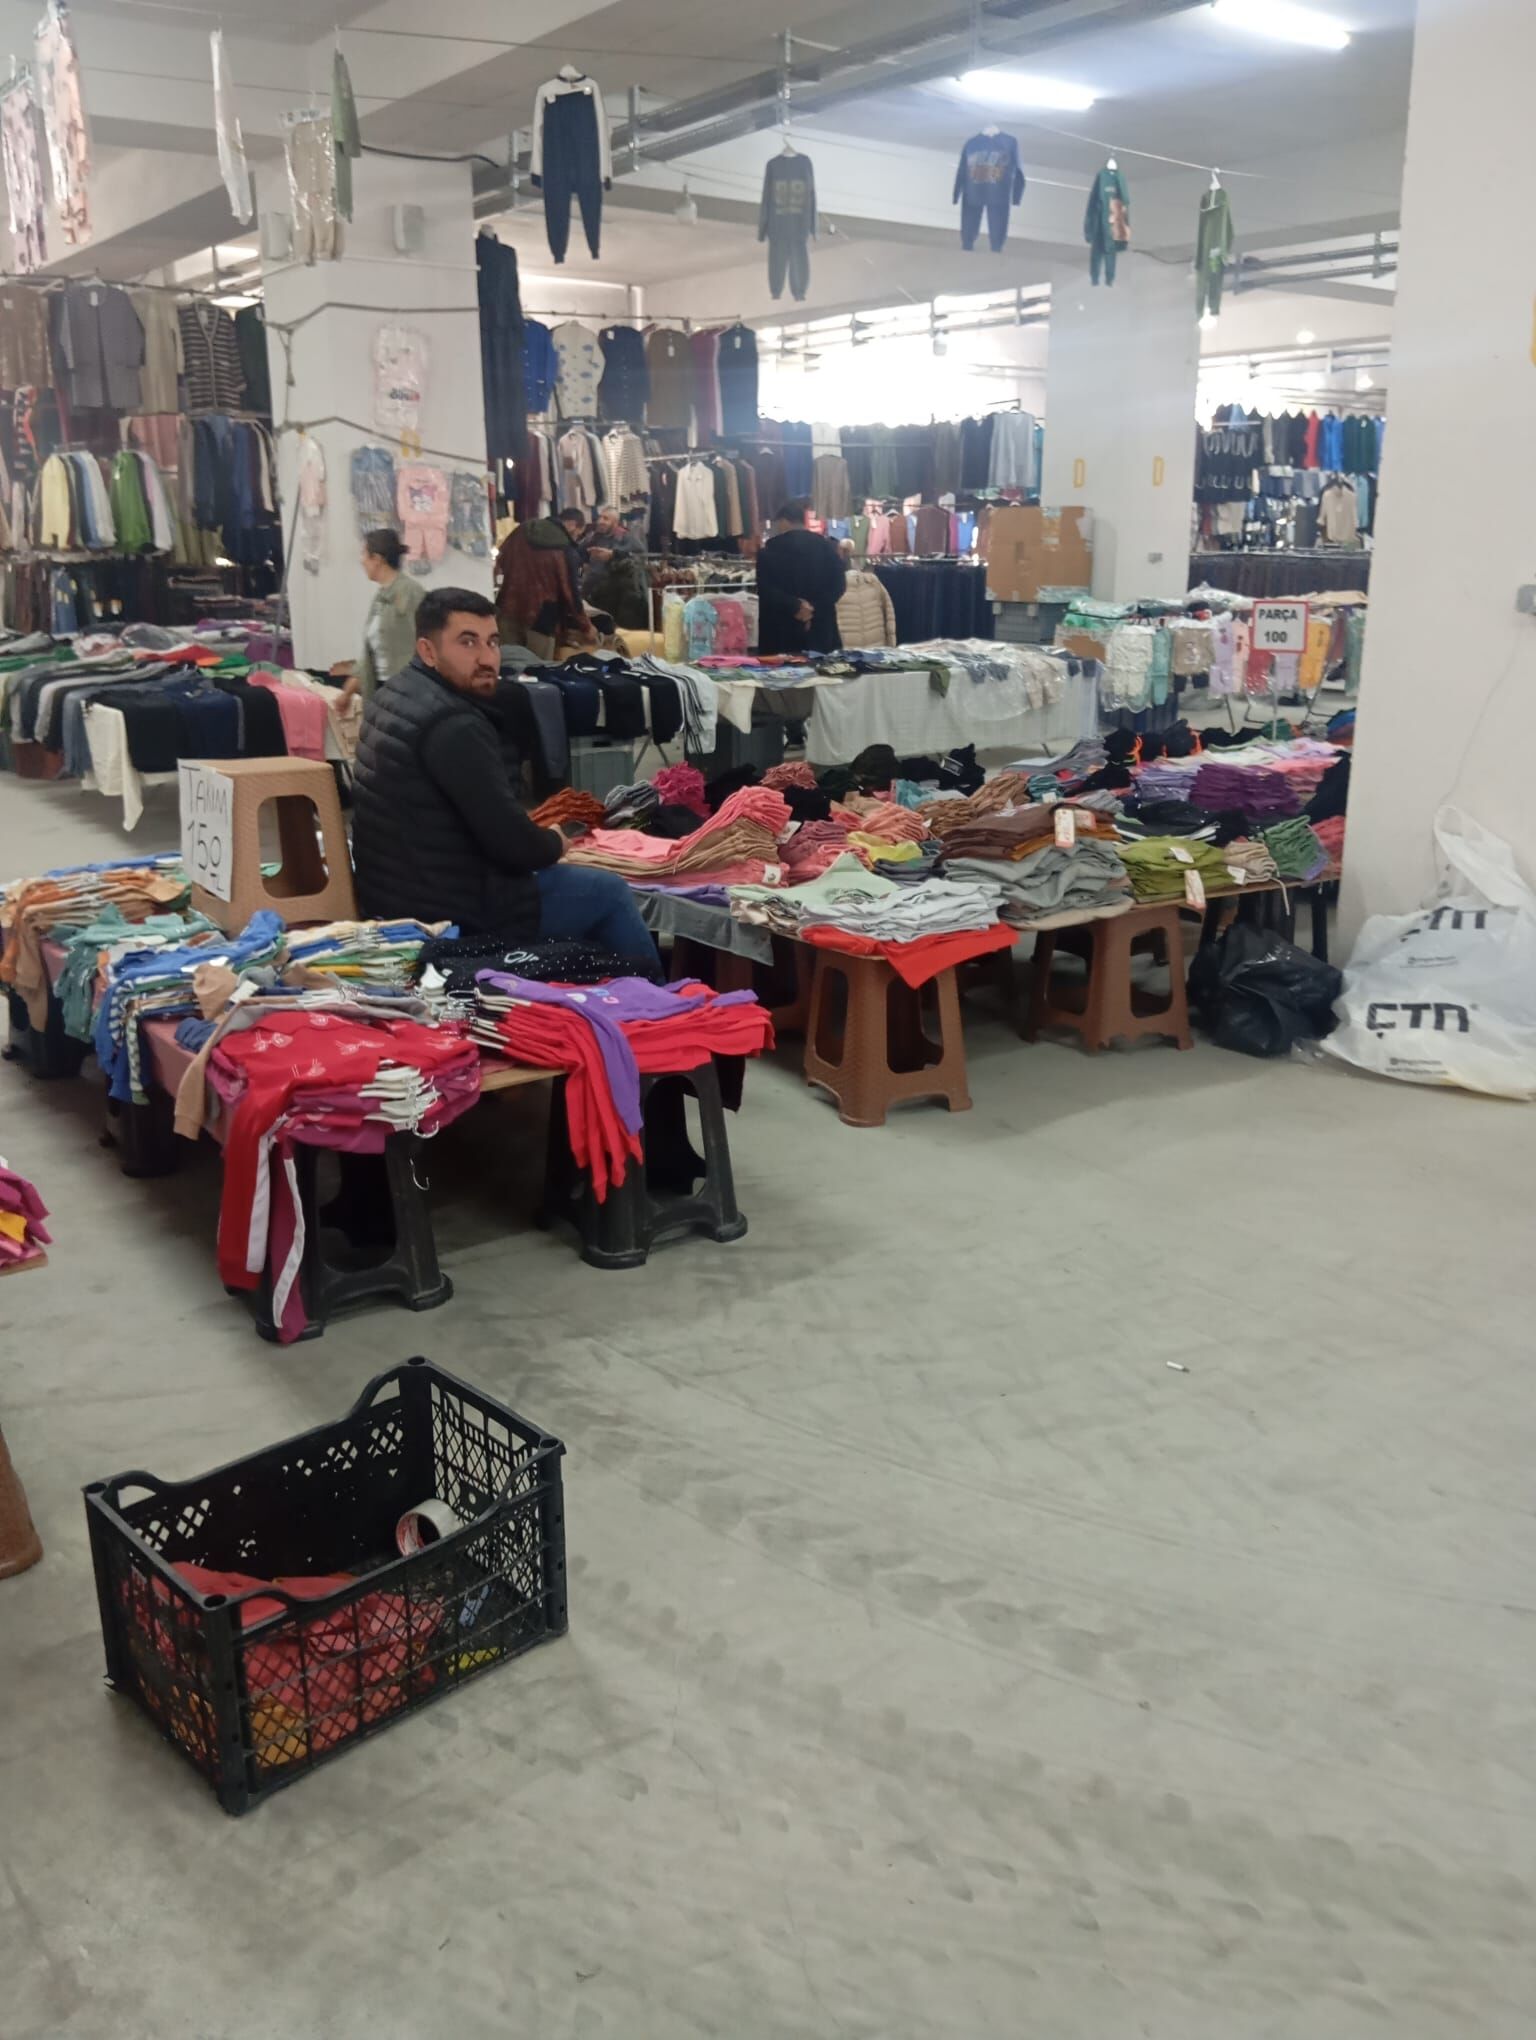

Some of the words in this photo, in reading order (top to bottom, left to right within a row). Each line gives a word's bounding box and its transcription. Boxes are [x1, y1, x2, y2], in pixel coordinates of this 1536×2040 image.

[1259, 608, 1298, 622] PARÇA
[1264, 631, 1288, 643] 100
[187, 820, 221, 870] 150
